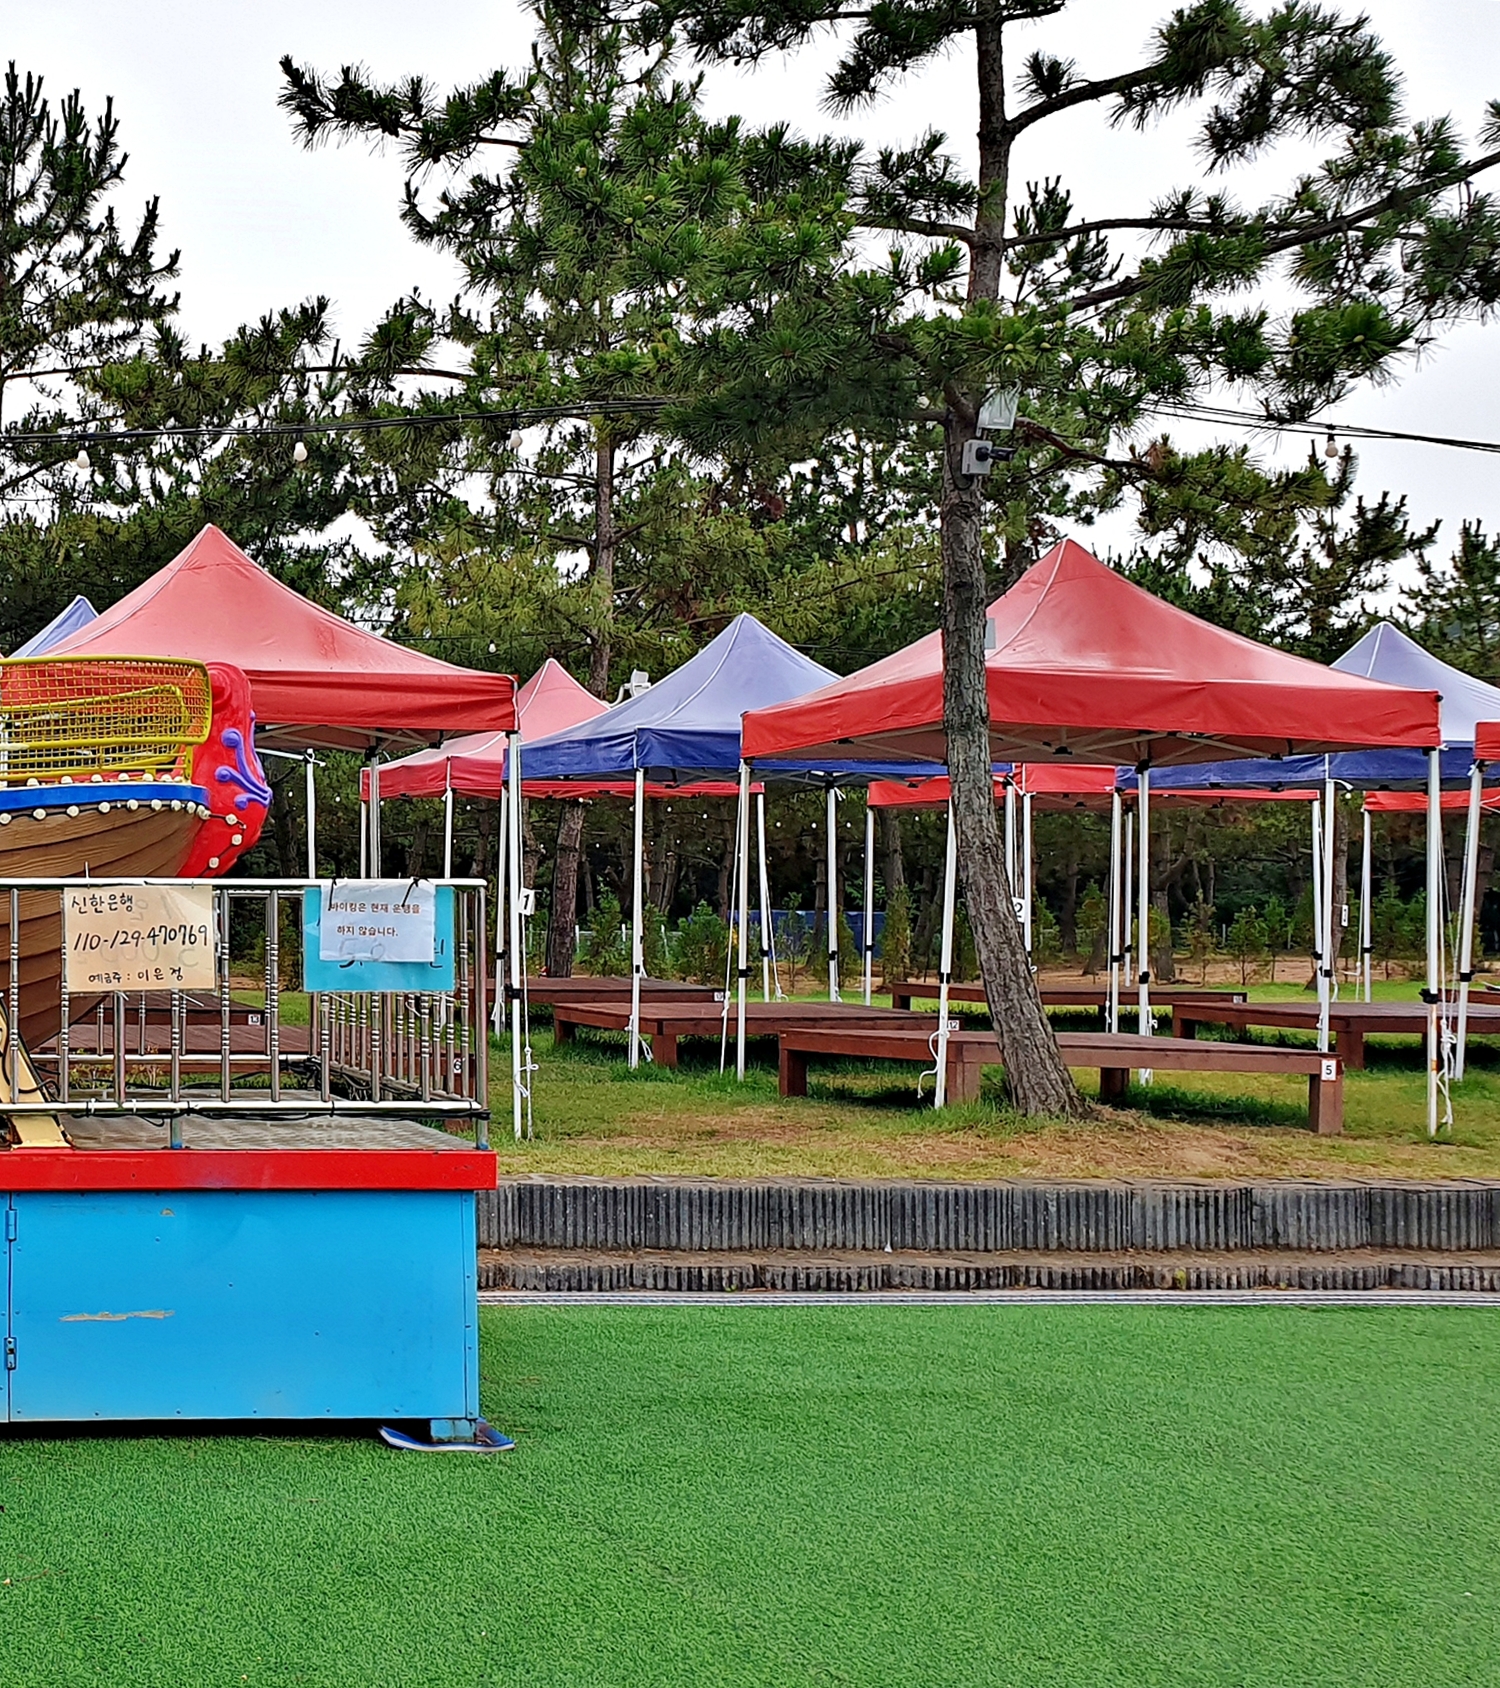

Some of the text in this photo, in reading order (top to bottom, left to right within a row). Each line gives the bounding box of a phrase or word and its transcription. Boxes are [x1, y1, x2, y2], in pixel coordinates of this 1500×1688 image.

[71, 892, 134, 914] 신한은행
[330, 902, 368, 913] 바이킹은
[370, 902, 389, 913] 현재
[523, 893, 530, 910] 1
[73, 924, 208, 951] 110-129-470769
[336, 925, 399, 937] 하지 않습니다.
[88, 971, 122, 984] 예금주
[1325, 1064, 1333, 1076] 5
